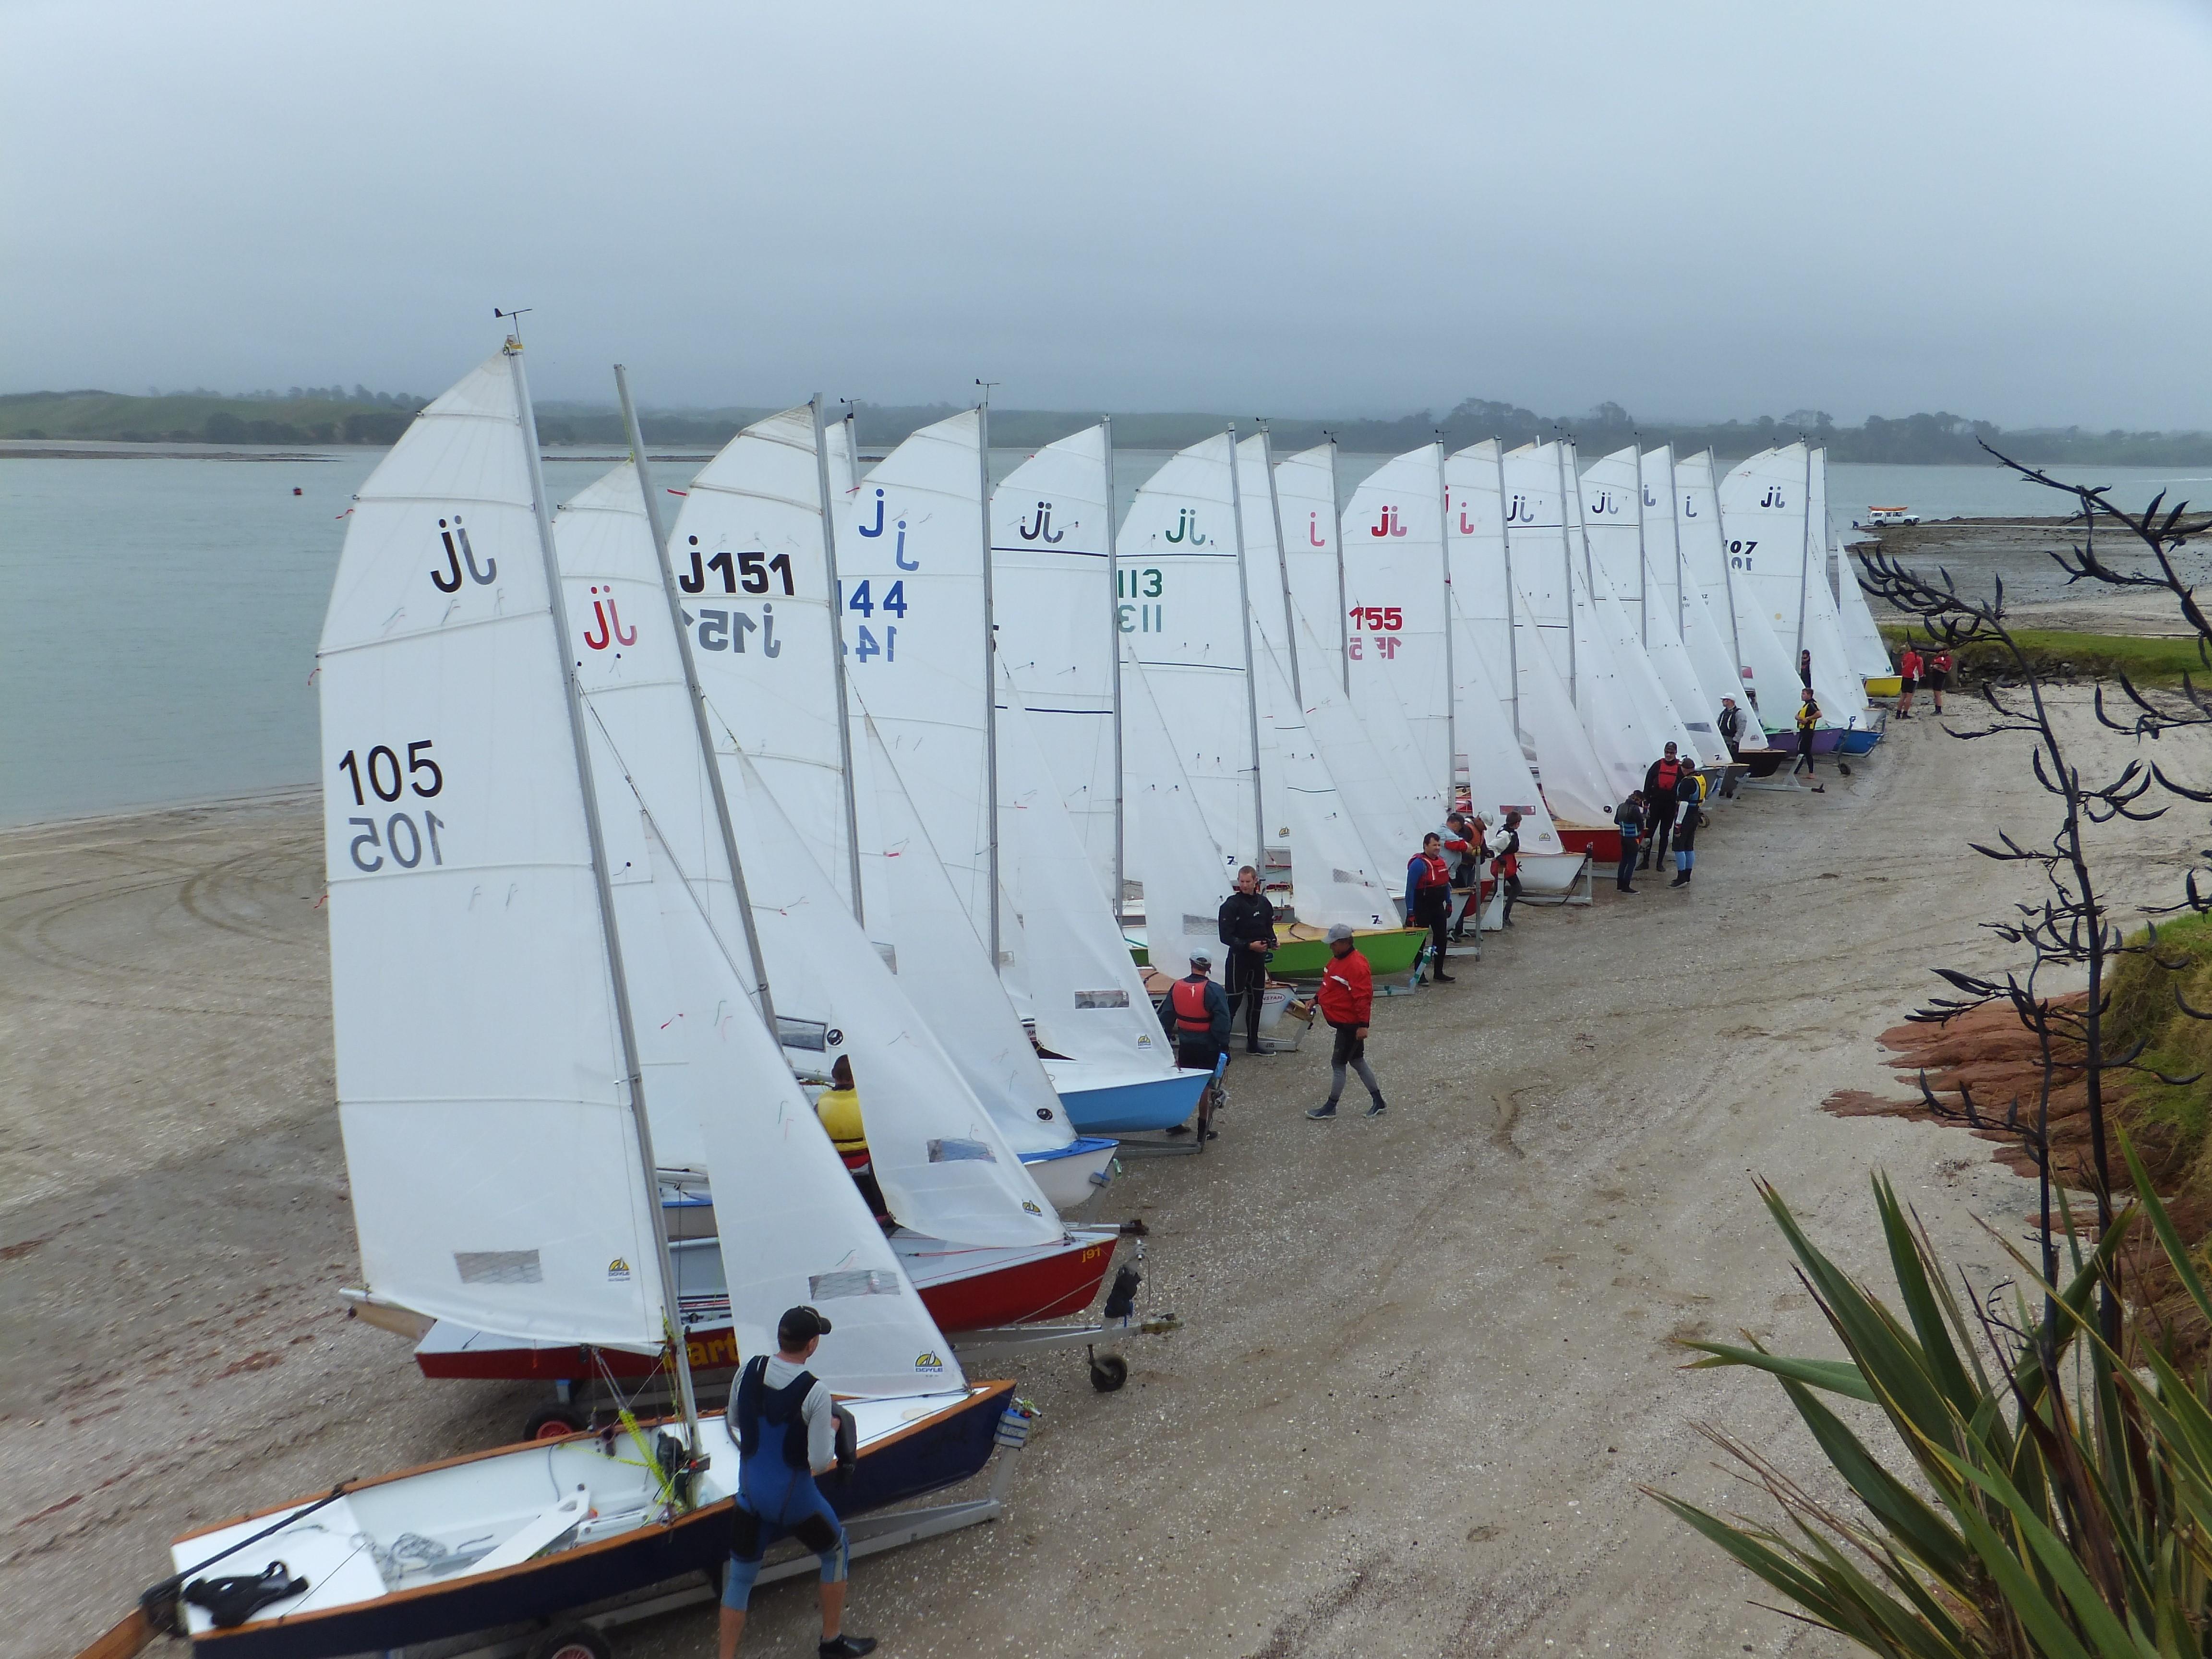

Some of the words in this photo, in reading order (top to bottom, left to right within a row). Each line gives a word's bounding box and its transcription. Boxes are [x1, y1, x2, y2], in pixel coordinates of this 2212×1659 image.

[1725, 540, 1758, 554] 07
[679, 535, 794, 596] j151
[1118, 569, 1162, 598] 113
[1349, 607, 1402, 630] 155
[339, 740, 443, 805] 105
[664, 1333, 739, 1367] art
